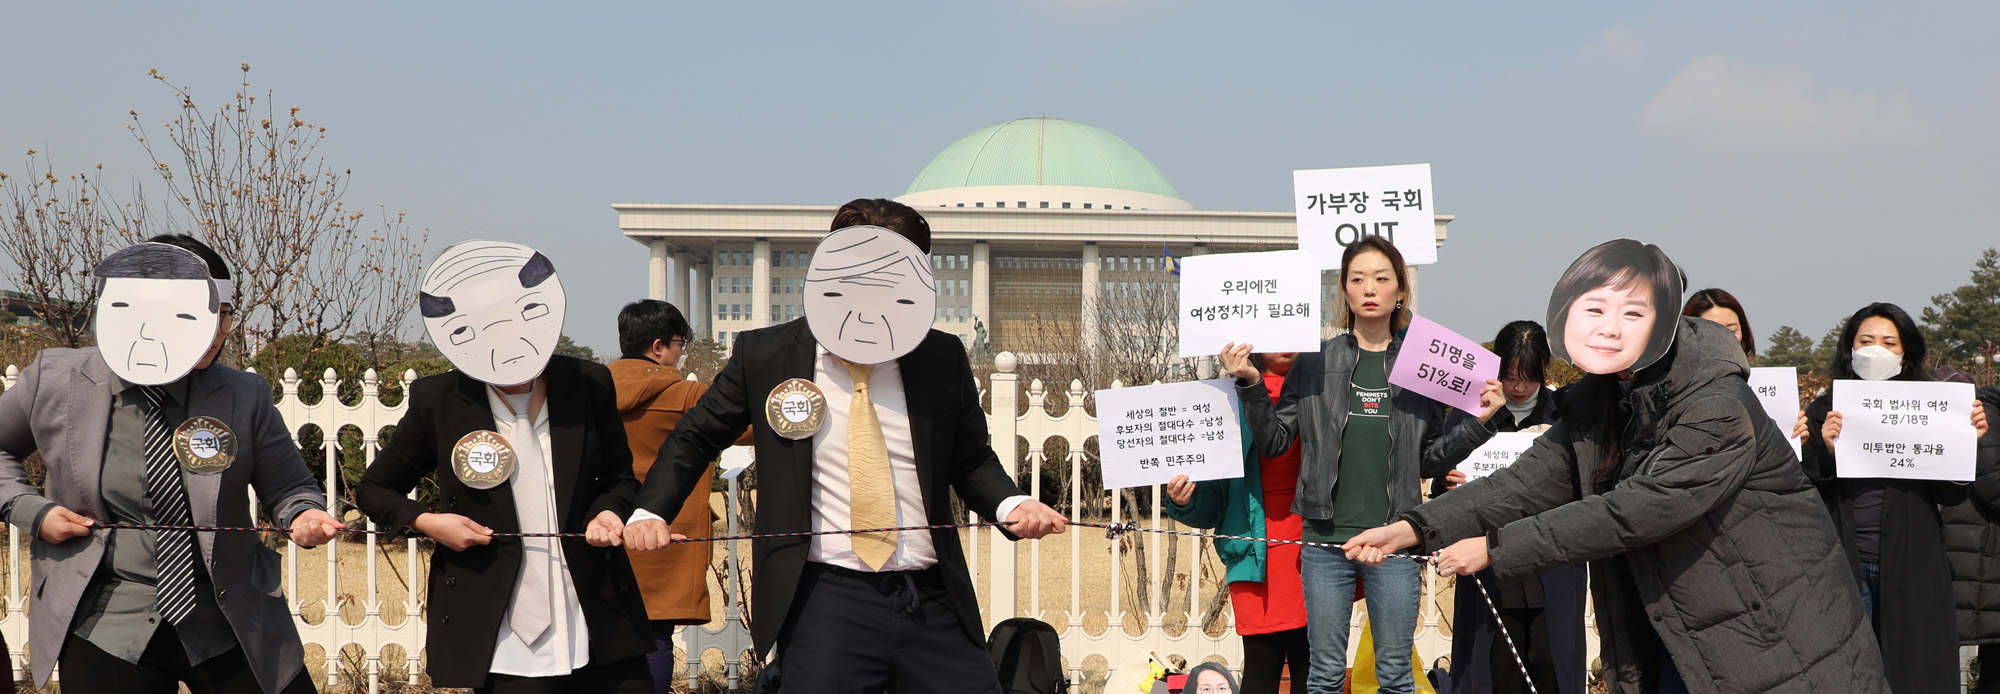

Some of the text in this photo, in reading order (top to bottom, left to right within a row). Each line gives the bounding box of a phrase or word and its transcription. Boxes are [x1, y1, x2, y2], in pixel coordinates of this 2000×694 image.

[1307, 189, 1422, 215] 가부장 국회
[1335, 221, 1399, 248] OUT
[1221, 279, 1277, 295] 우리에겐
[1190, 302, 1310, 321] 여성정치가 필요해
[1428, 338, 1477, 371] 51명을
[1417, 363, 1472, 396] 51%로!
[1758, 385, 1777, 397] 여성
[783, 400, 810, 416] 국회
[1126, 408, 1154, 420] 세상의
[1159, 406, 1177, 418] 절반
[1192, 403, 1211, 414] 여성
[1861, 399, 1949, 412] 국회 법사위 여성
[1116, 422, 1153, 435] 후보자의
[1158, 419, 1195, 432] 절대다수
[1881, 414, 1929, 426] 2명/18명
[191, 437, 219, 452] 국회
[1116, 436, 1154, 449] 당선자의
[1159, 433, 1196, 446] 절대다수
[1862, 442, 1945, 455] 미투법안 통과율
[469, 451, 497, 468] 국회
[1140, 453, 1206, 469] 반쪽 민주주의
[1484, 451, 1508, 460] 세상의
[1889, 458, 1915, 468] 24%
